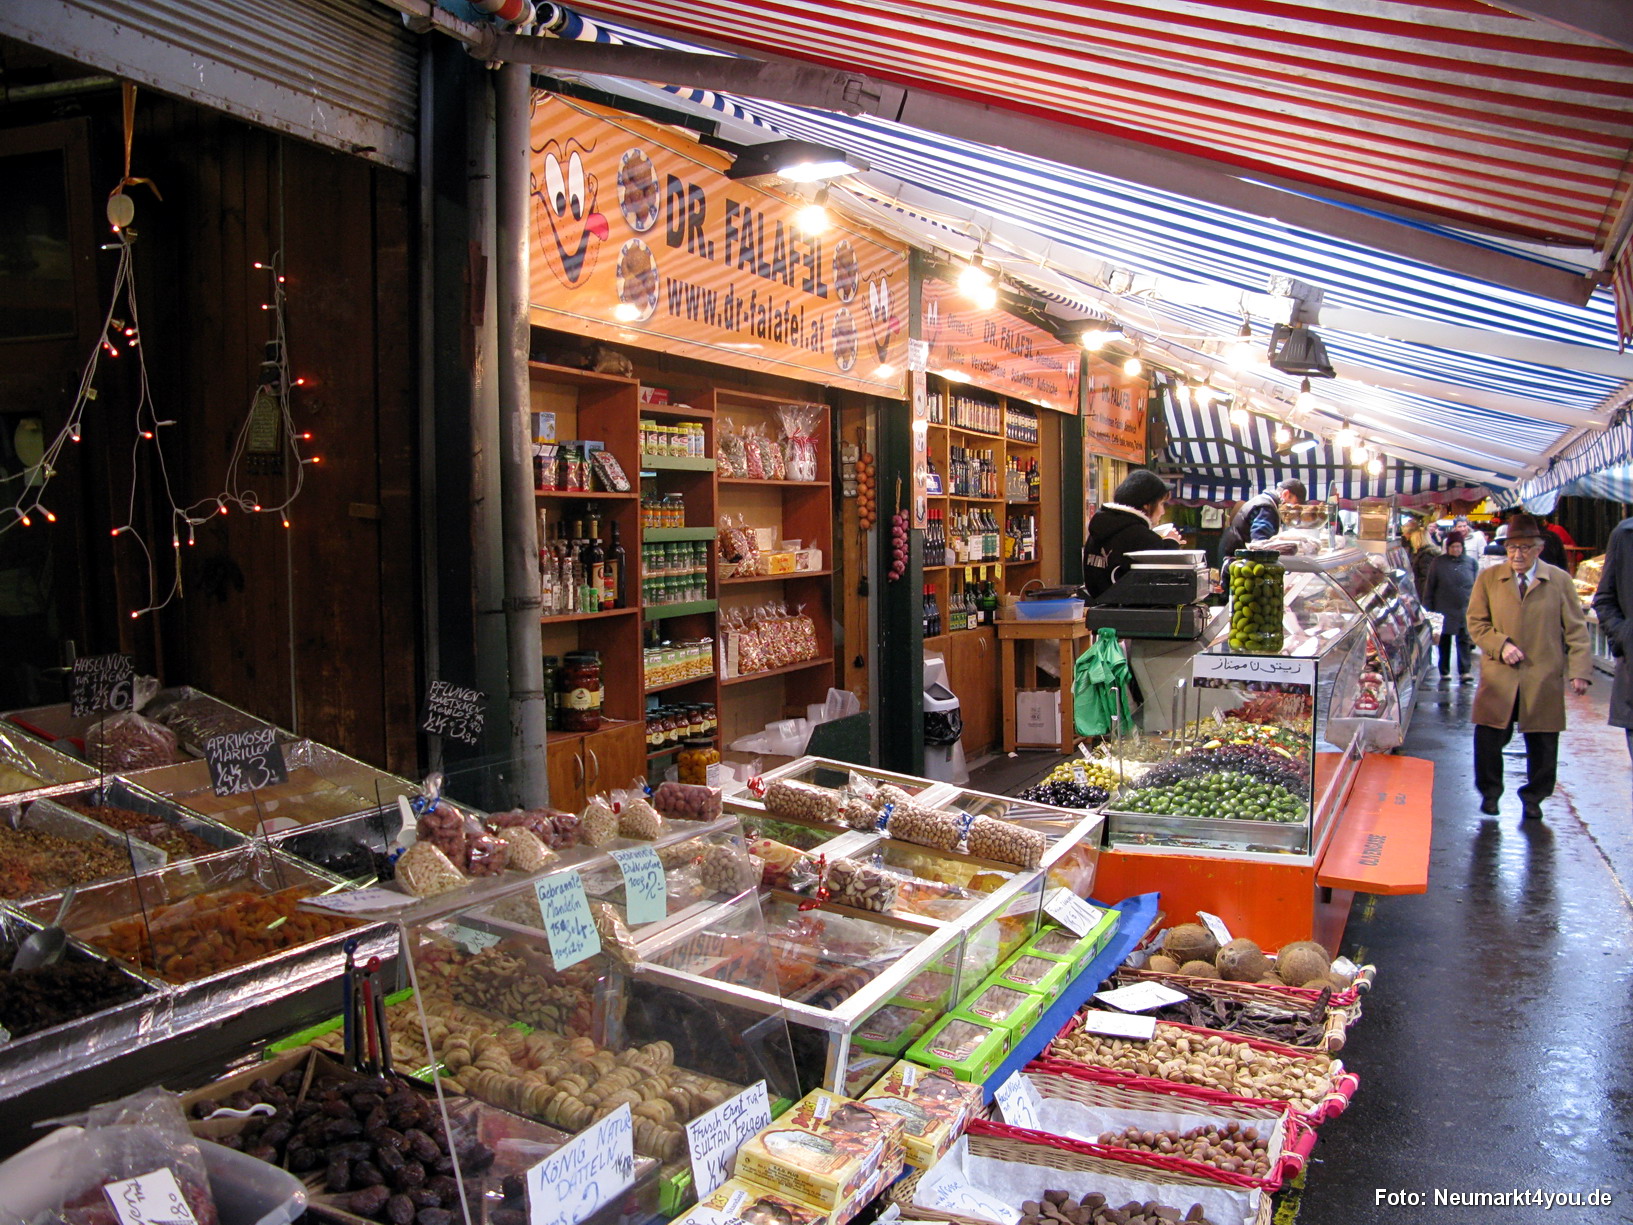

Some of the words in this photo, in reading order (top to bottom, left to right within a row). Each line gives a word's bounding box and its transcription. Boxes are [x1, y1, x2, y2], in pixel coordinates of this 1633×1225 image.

[667, 174, 715, 262] DR.
[725, 198, 828, 299] FALAFEL
[667, 276, 826, 354] www.dr-falafel.at
[983, 319, 998, 347] DR.
[1000, 327, 1034, 361] FALAFEL
[207, 727, 279, 751] APRIKOSEN
[210, 742, 275, 765] MARILLEN
[546, 894, 582, 919] Mandeln
[690, 1112, 722, 1143] Frisch
[694, 1123, 731, 1161] SULTAN
[732, 1111, 770, 1146] Feigen
[541, 1139, 586, 1191] KÖNIG
[596, 1110, 632, 1151] NATUR
[556, 1142, 618, 1202] DATTELN
[726, 1190, 745, 1215] Standard
